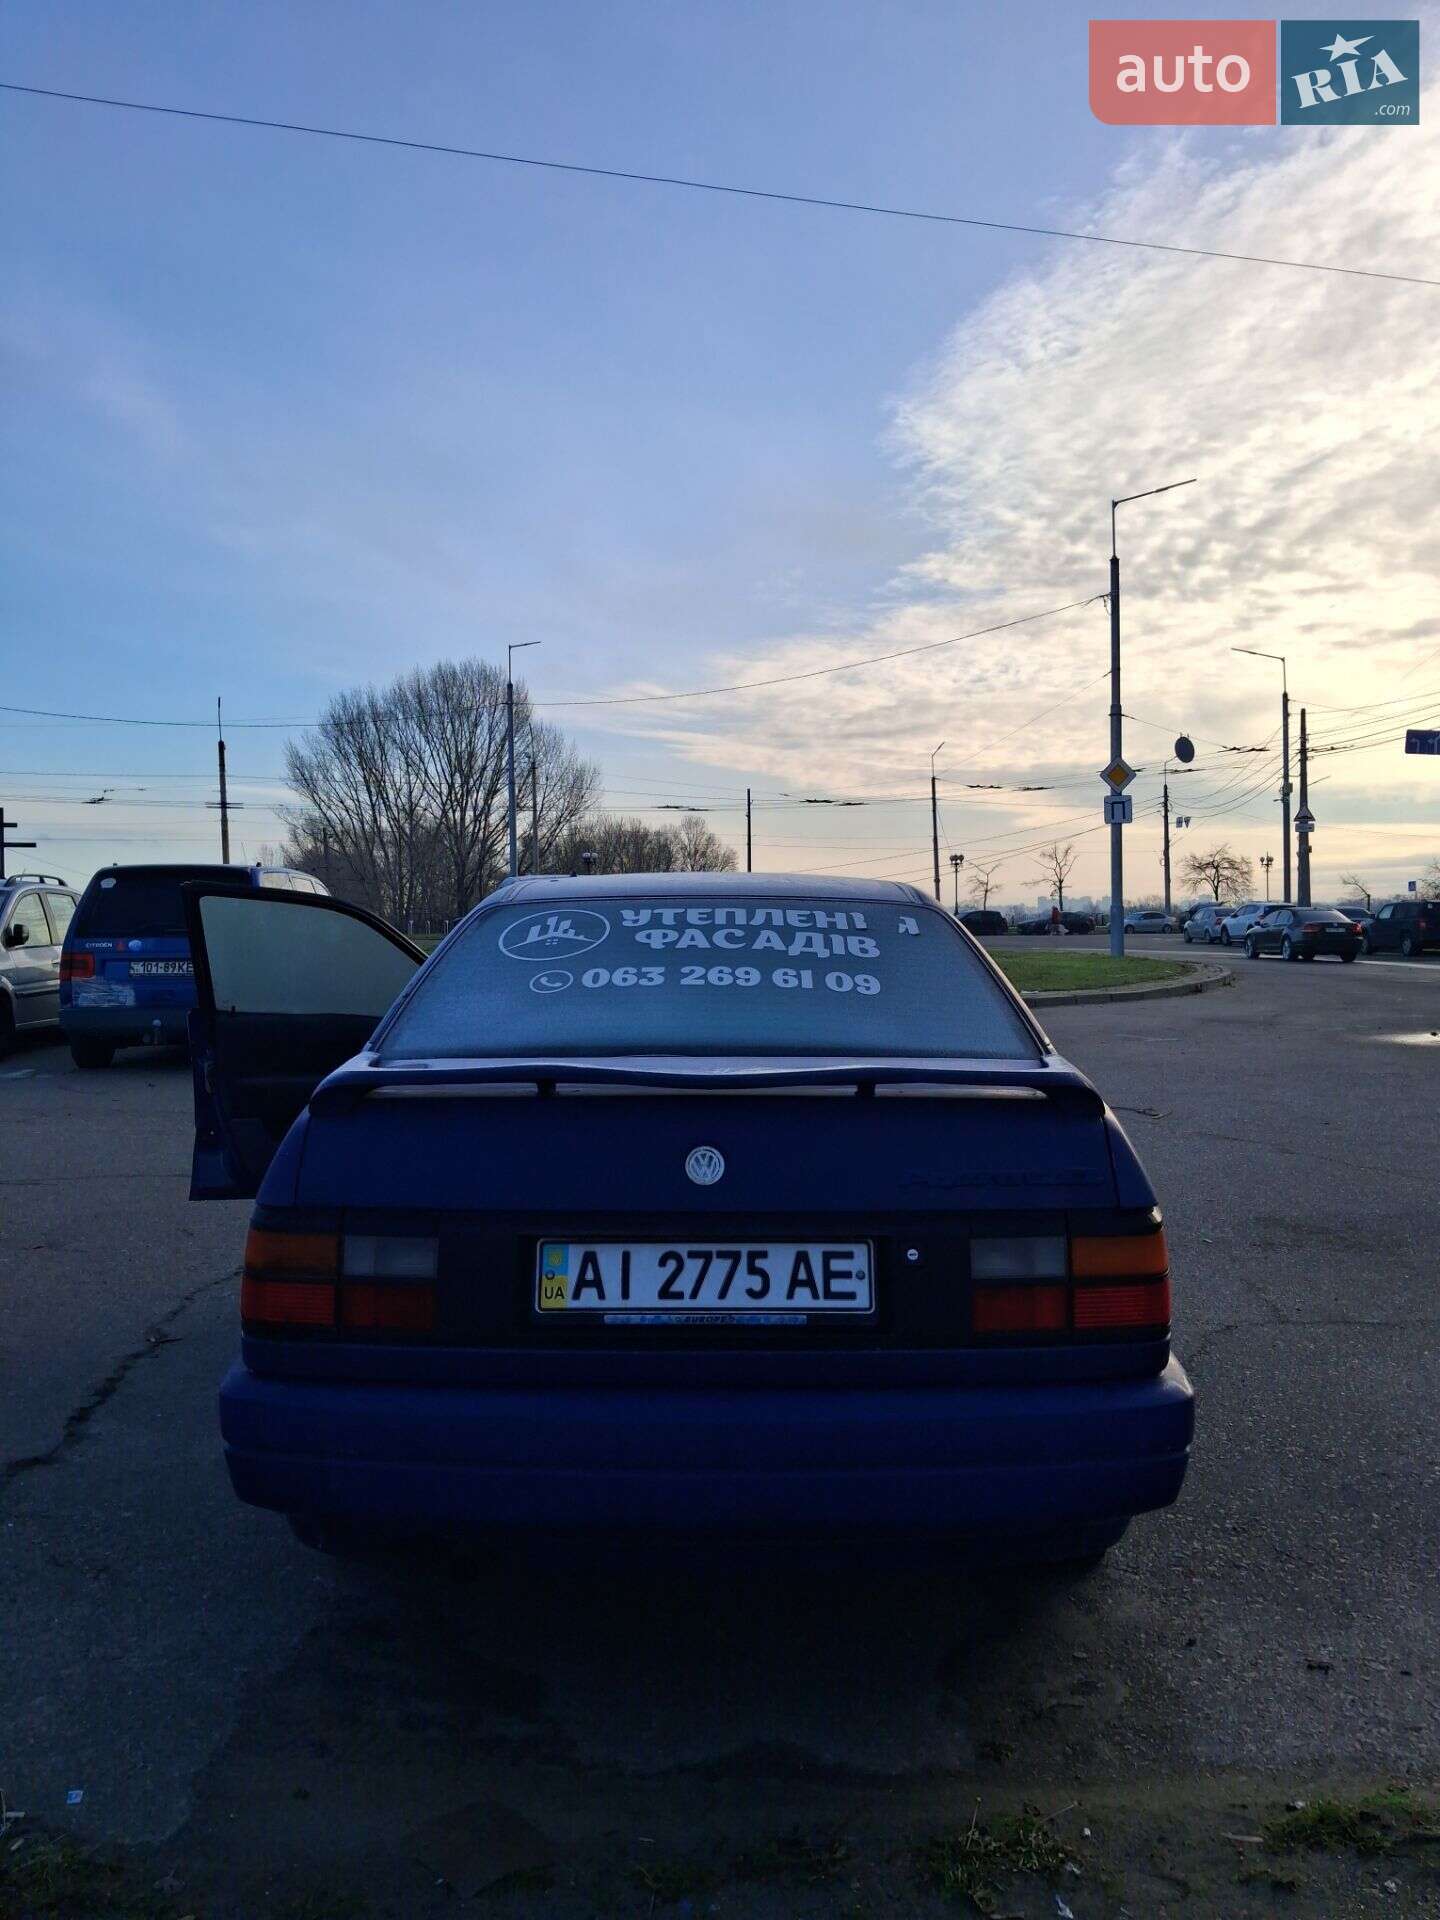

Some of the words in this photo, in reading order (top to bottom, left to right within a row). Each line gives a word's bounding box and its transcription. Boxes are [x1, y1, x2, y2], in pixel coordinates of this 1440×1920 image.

[635, 929, 881, 958] ФАСАДІВ
[581, 966, 665, 988] 063
[680, 965, 762, 987] 269
[771, 967, 814, 989] 61
[825, 971, 881, 995] 09
[571, 1250, 631, 1301] AI
[657, 1250, 771, 1301] 2775
[786, 1250, 858, 1301] AE
[544, 1286, 565, 1300] UA
